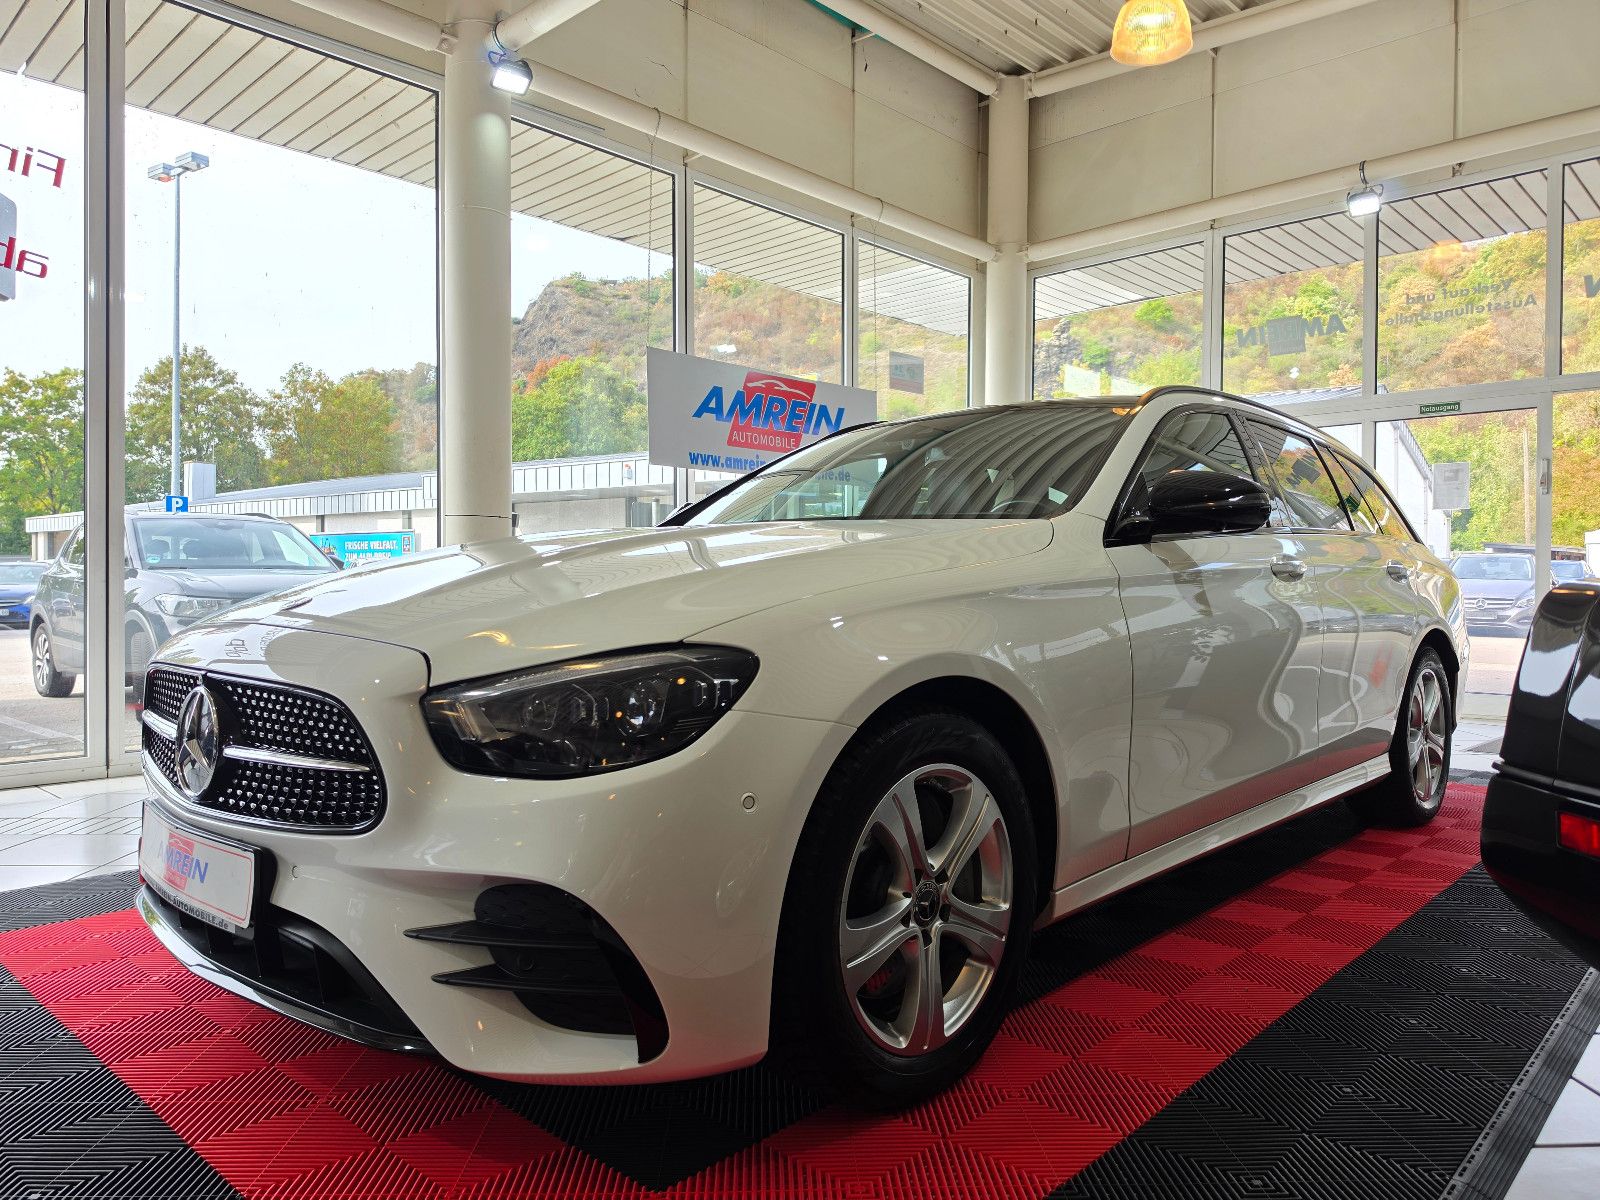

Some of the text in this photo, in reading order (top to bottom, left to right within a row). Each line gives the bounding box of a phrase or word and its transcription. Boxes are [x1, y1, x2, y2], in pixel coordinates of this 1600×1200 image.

[692, 385, 845, 435] AMREIN
[1420, 404, 1459, 413] Notausgang
[732, 431, 796, 449] AUTOMOBILE
[171, 497, 183, 512] P
[345, 541, 368, 550] FRISCHE
